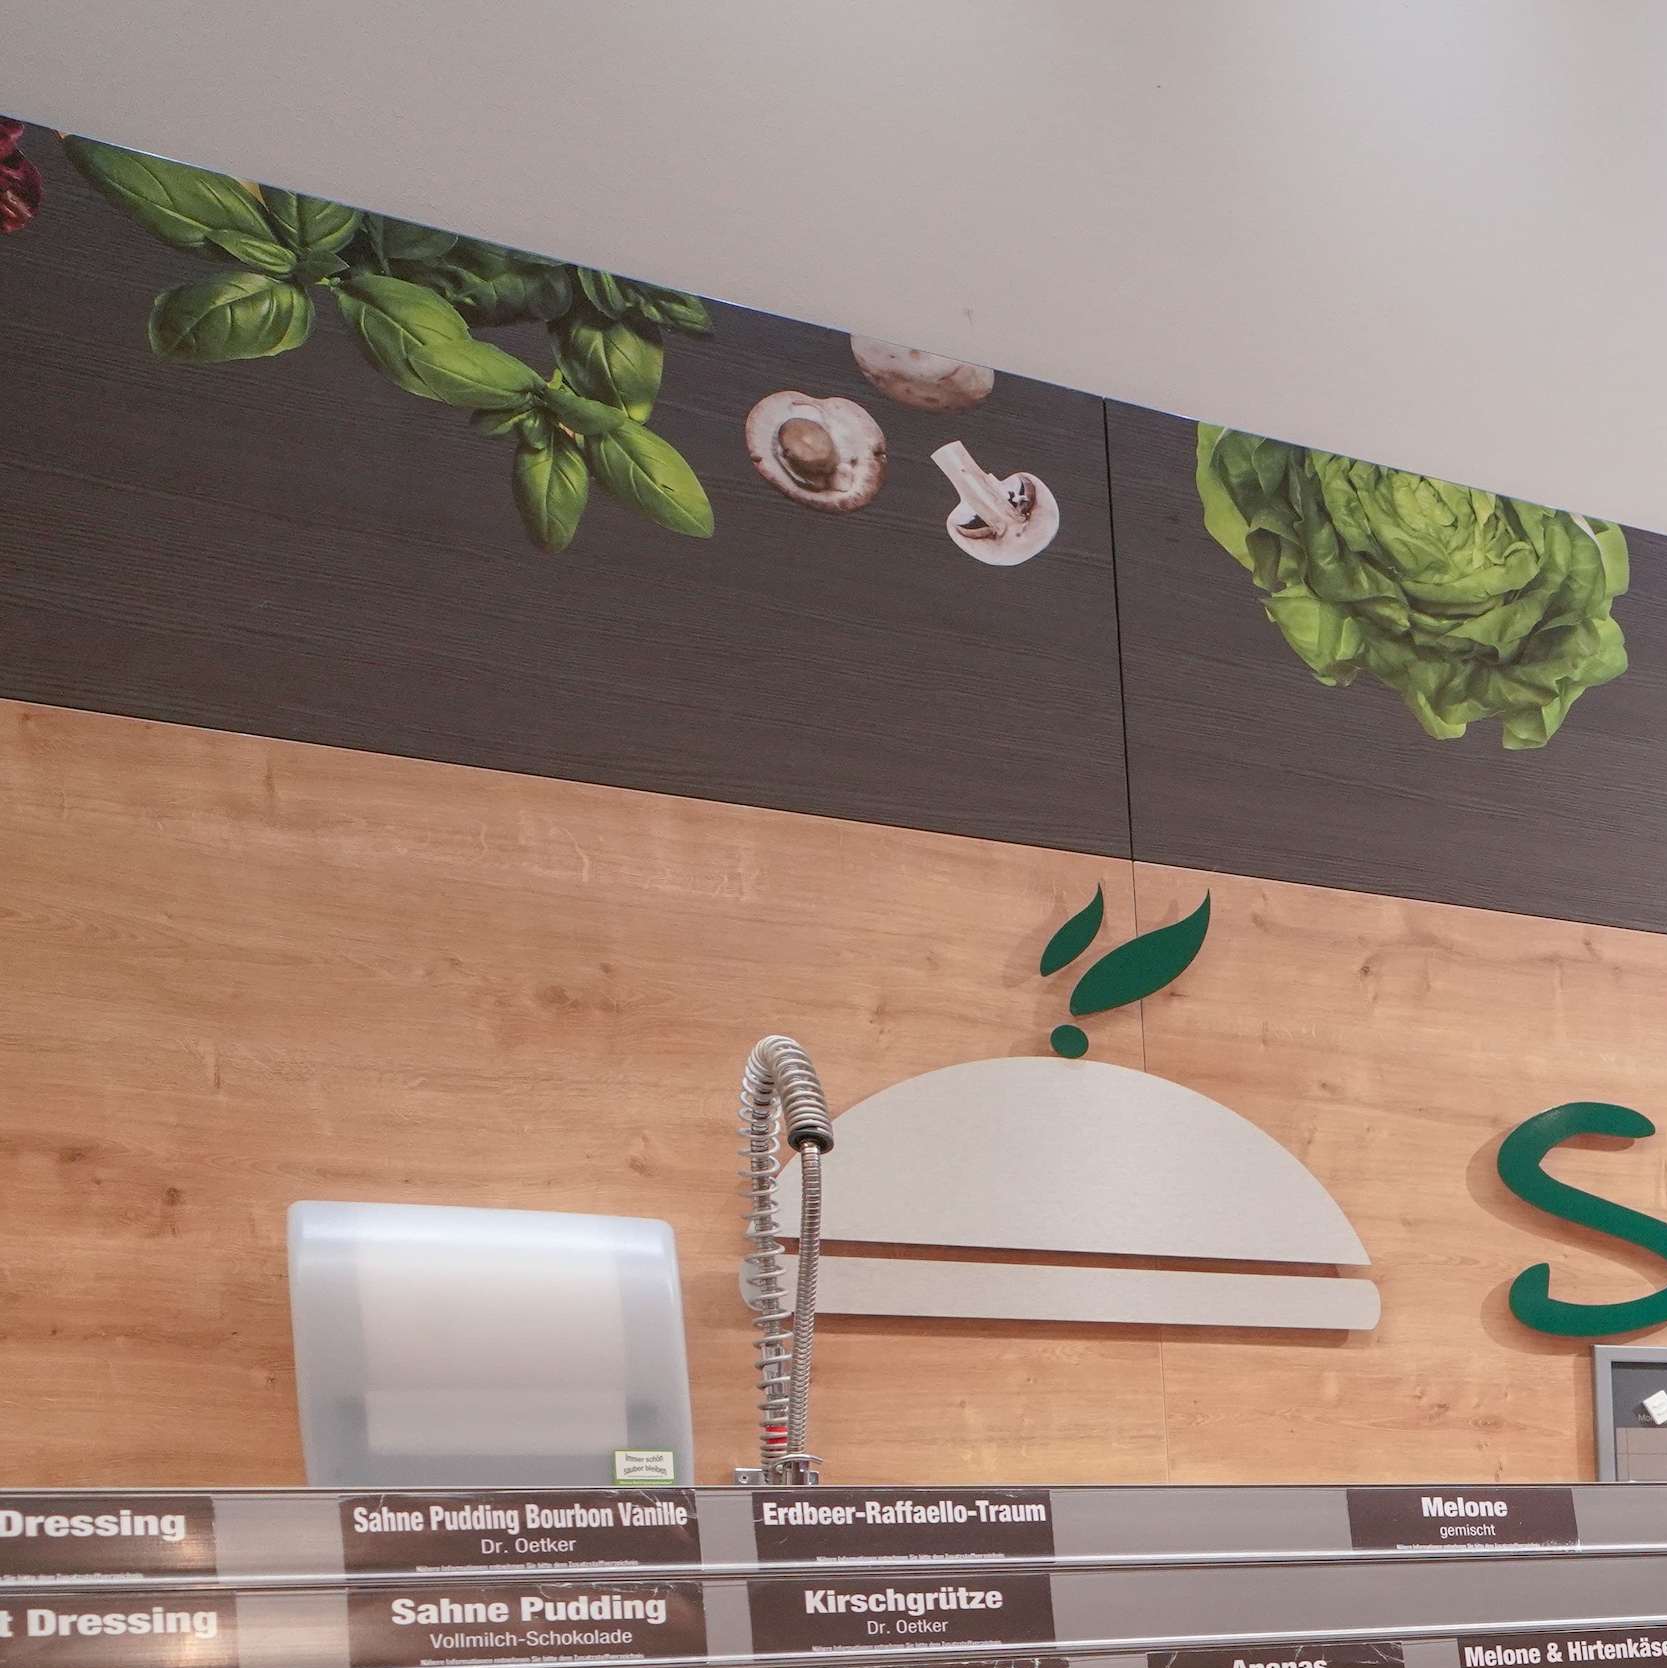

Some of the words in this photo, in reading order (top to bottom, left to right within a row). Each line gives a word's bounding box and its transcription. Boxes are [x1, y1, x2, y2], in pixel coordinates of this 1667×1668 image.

[625, 1453, 644, 1462] Immer
[624, 1465, 643, 1475] sauber
[645, 1465, 667, 1475] bleiben
[354, 1505, 424, 1533] Sahne
[430, 1505, 520, 1535] Pudding
[525, 1503, 614, 1529] Bourbon
[618, 1501, 688, 1526] Vanille
[762, 1499, 1046, 1526] Erdbeer-Raffaello-Traum
[1421, 1497, 1508, 1518] Melone
[0, 1509, 186, 1541] Dressing
[1439, 1523, 1496, 1539] gemischt
[481, 1538, 508, 1554] Dr.
[515, 1537, 577, 1553] Oetker
[391, 1597, 509, 1625] Sahne
[520, 1595, 667, 1624] Pudding
[804, 1586, 1003, 1617] Kirschgrütze
[27, 1607, 217, 1638] Dressing
[867, 1620, 890, 1635] Dr.
[896, 1619, 948, 1634] Oetker
[430, 1629, 633, 1649] Vollmilch-Schokolade
[1464, 1646, 1541, 1668] Melone
[1546, 1643, 1563, 1663] &
